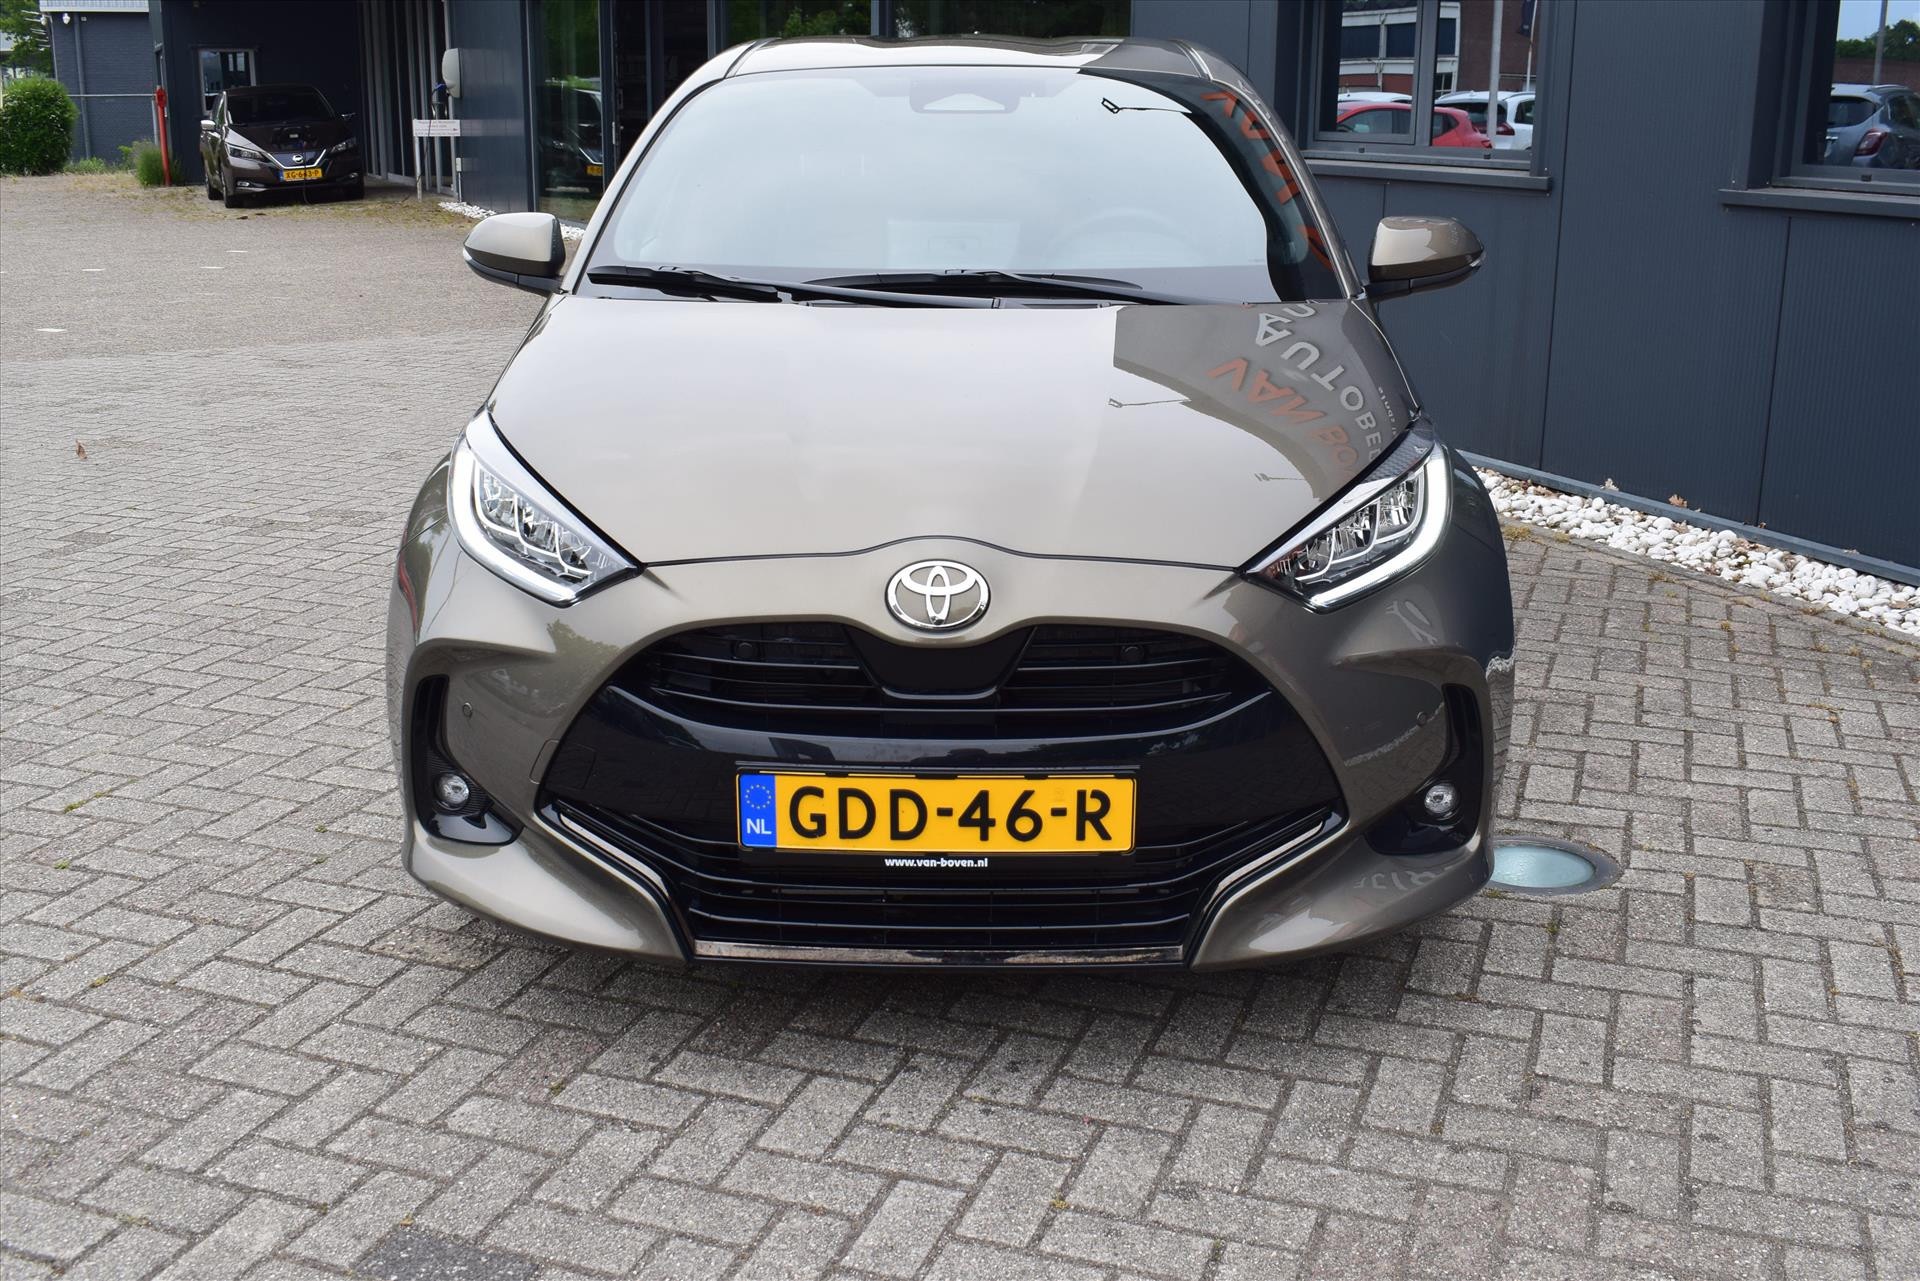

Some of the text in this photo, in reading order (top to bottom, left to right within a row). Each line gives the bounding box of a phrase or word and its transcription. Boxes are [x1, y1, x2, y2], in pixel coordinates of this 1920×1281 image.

[789, 785, 1112, 843] GDD-46-R
[746, 817, 773, 835] NL
[884, 858, 989, 868] www.van-boven.nl
